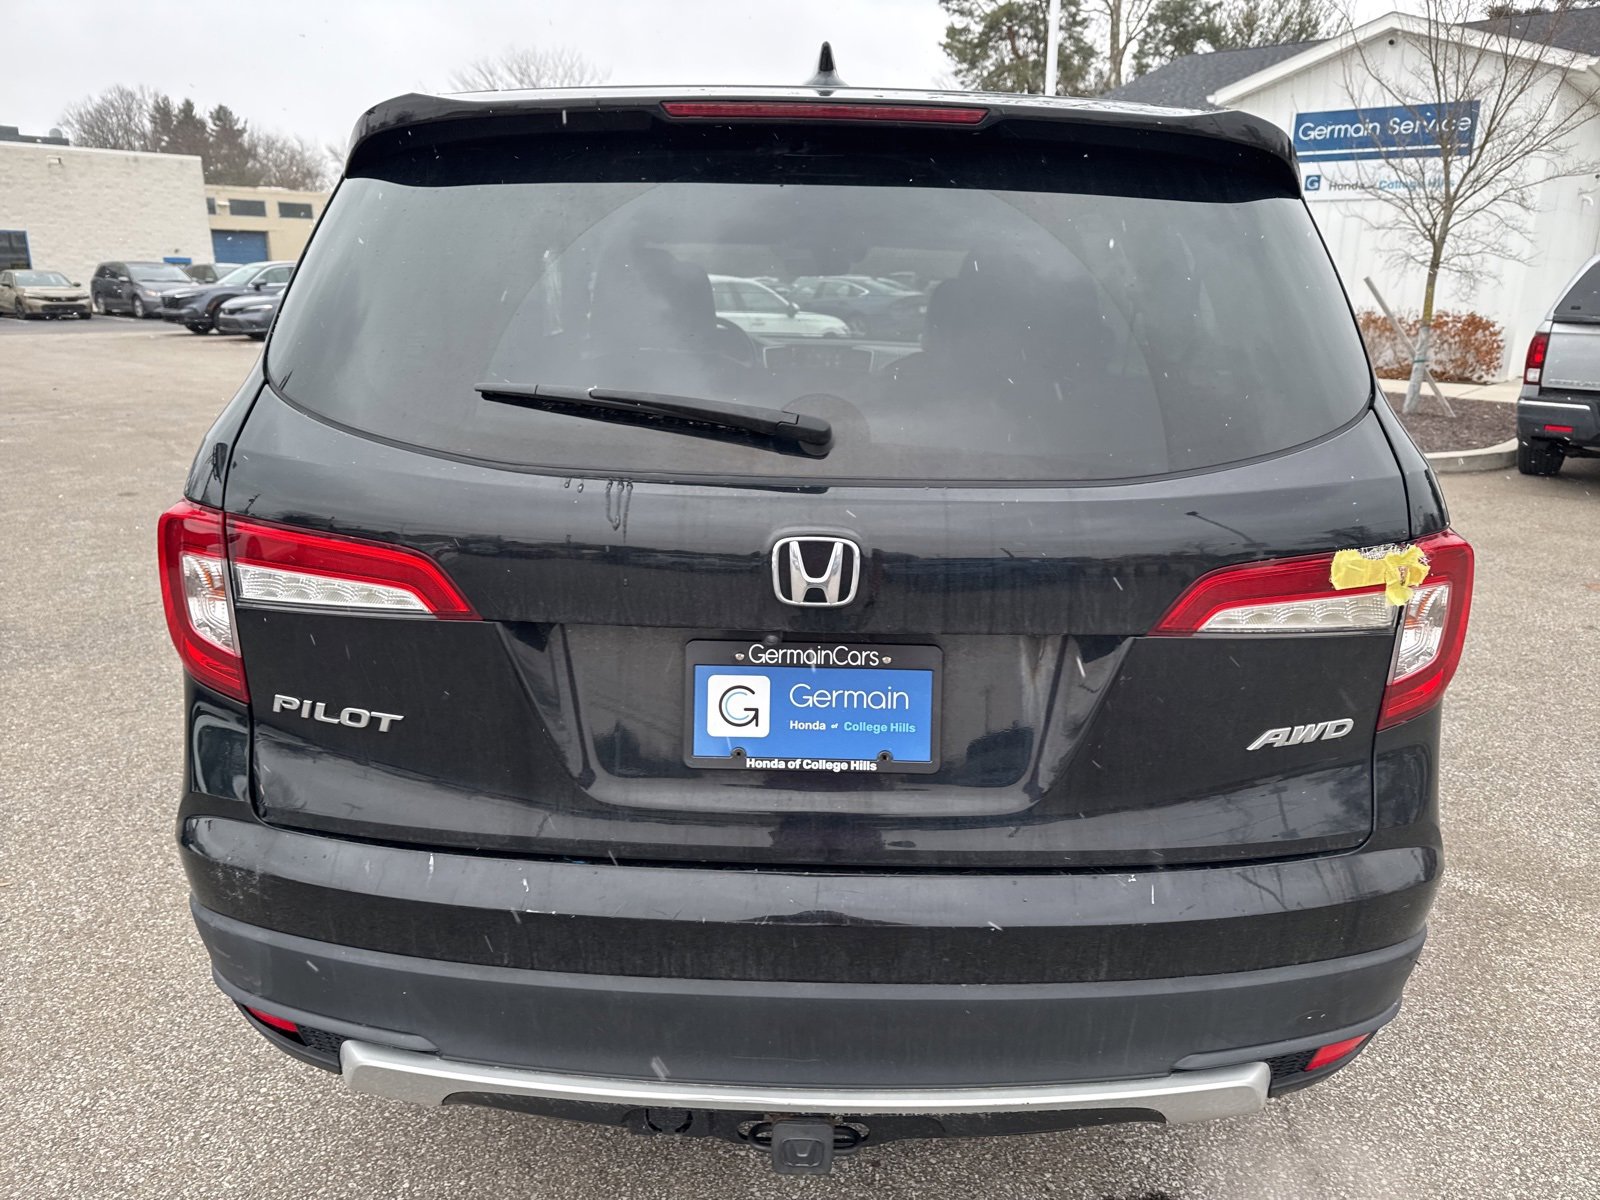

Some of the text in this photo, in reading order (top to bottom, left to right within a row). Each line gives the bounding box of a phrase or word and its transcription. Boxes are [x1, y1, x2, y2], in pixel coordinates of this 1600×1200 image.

[1299, 116, 1472, 141] Germain Service
[748, 643, 880, 667] GermainCars
[789, 683, 910, 710] Germain
[272, 693, 405, 733] PILOT
[789, 720, 826, 730] Honda
[843, 721, 887, 734] College
[890, 722, 916, 733] Hills
[1246, 718, 1355, 751] AWD
[745, 757, 878, 772] Honda of College Hills
